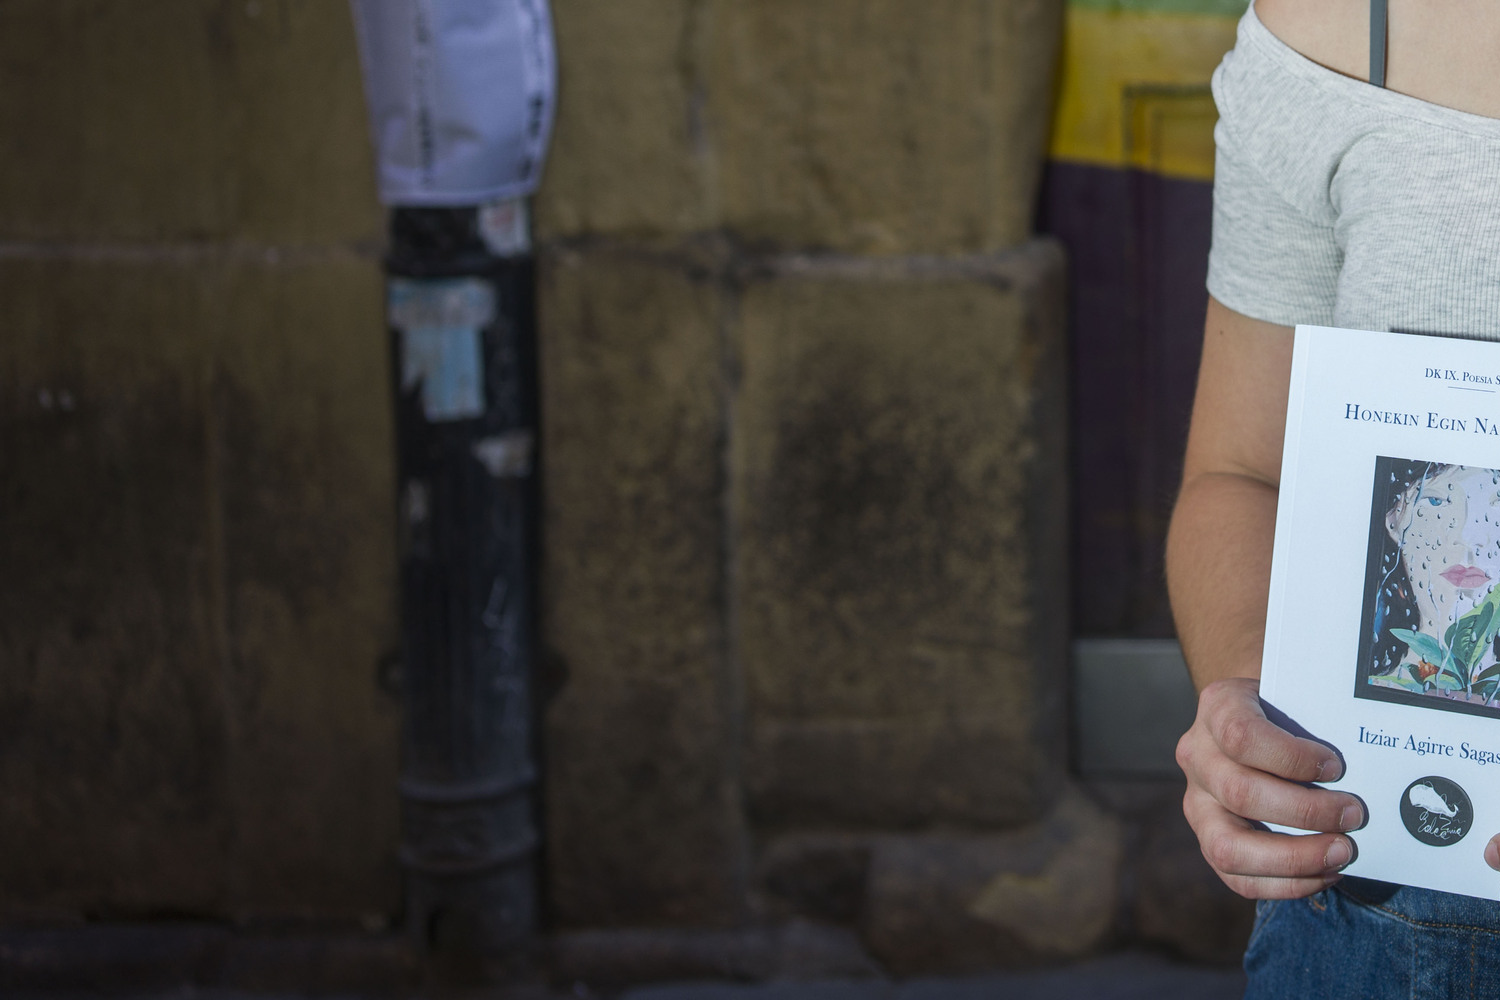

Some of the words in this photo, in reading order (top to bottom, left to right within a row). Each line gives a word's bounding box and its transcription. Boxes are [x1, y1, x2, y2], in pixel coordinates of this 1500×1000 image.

[1424, 367, 1442, 379] DK
[1444, 369, 1460, 381] IX.
[1357, 726, 1400, 749] Itziar
[1403, 733, 1455, 757] Agirre
